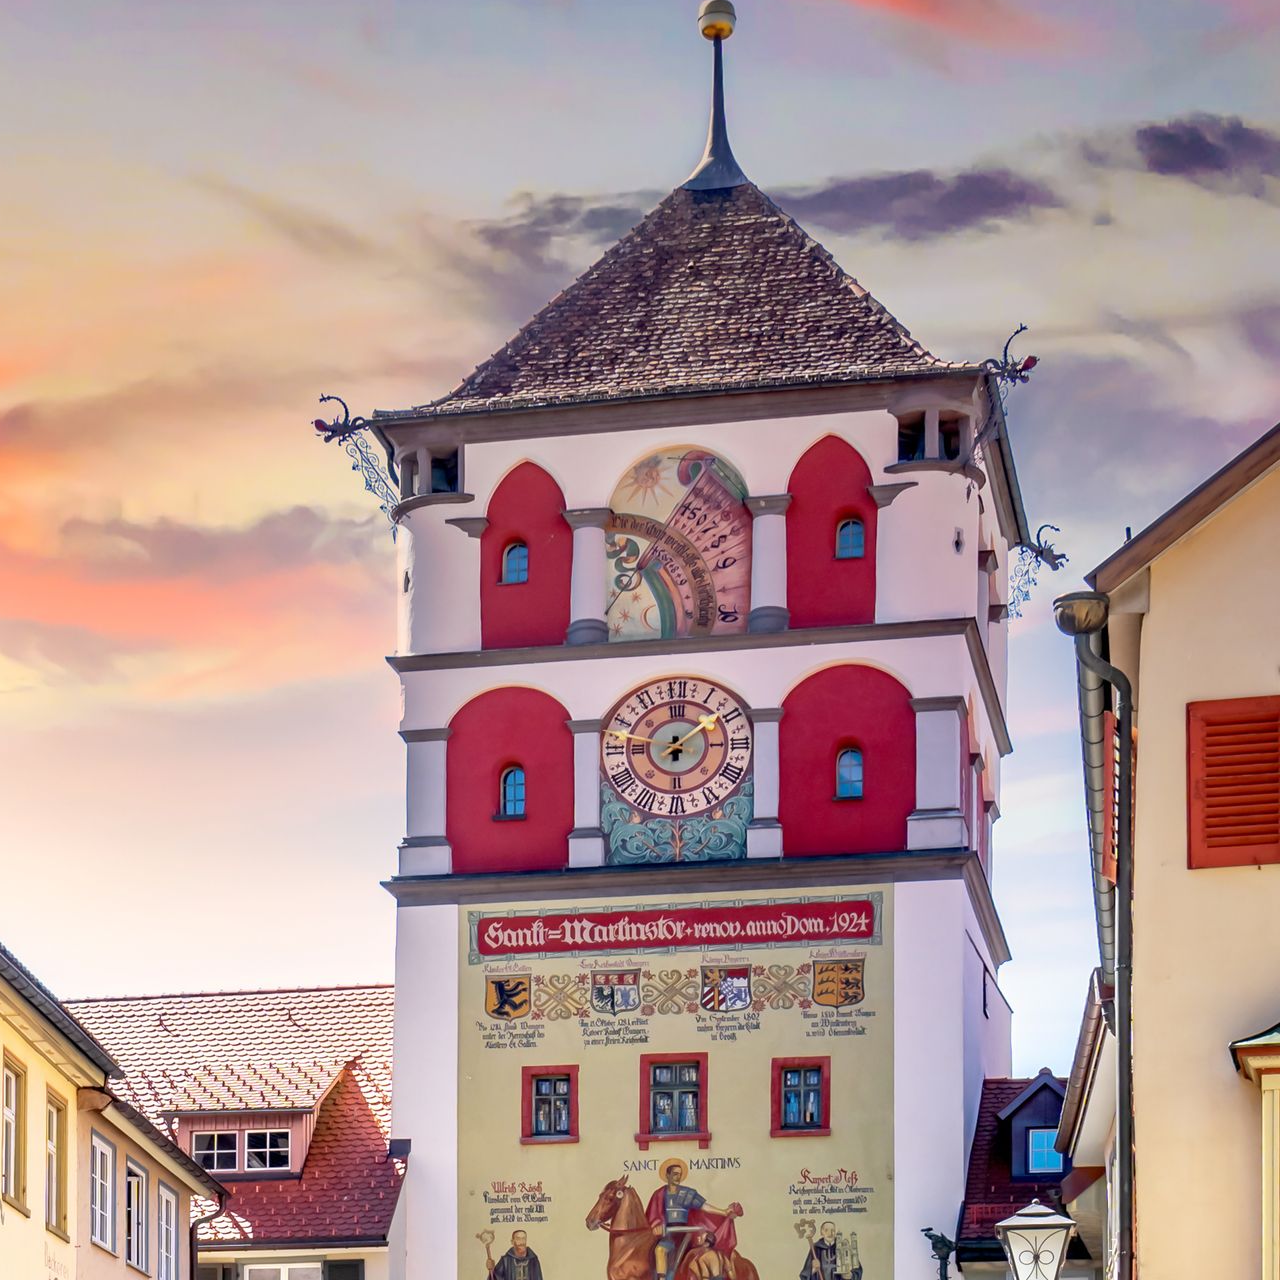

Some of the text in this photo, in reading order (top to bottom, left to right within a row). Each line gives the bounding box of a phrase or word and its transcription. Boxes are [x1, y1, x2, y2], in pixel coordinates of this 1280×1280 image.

[687, 507, 702, 520] 5
[701, 520, 719, 534] 7
[711, 535, 728, 548] 8
[827, 911, 870, 935] 1924
[743, 1012, 760, 1021] 1802
[623, 1159, 659, 1171] SANCT
[798, 1168, 833, 1187] Rupert
[491, 1181, 542, 1194] Ulrich Rösch
[515, 1205, 523, 1213] der
